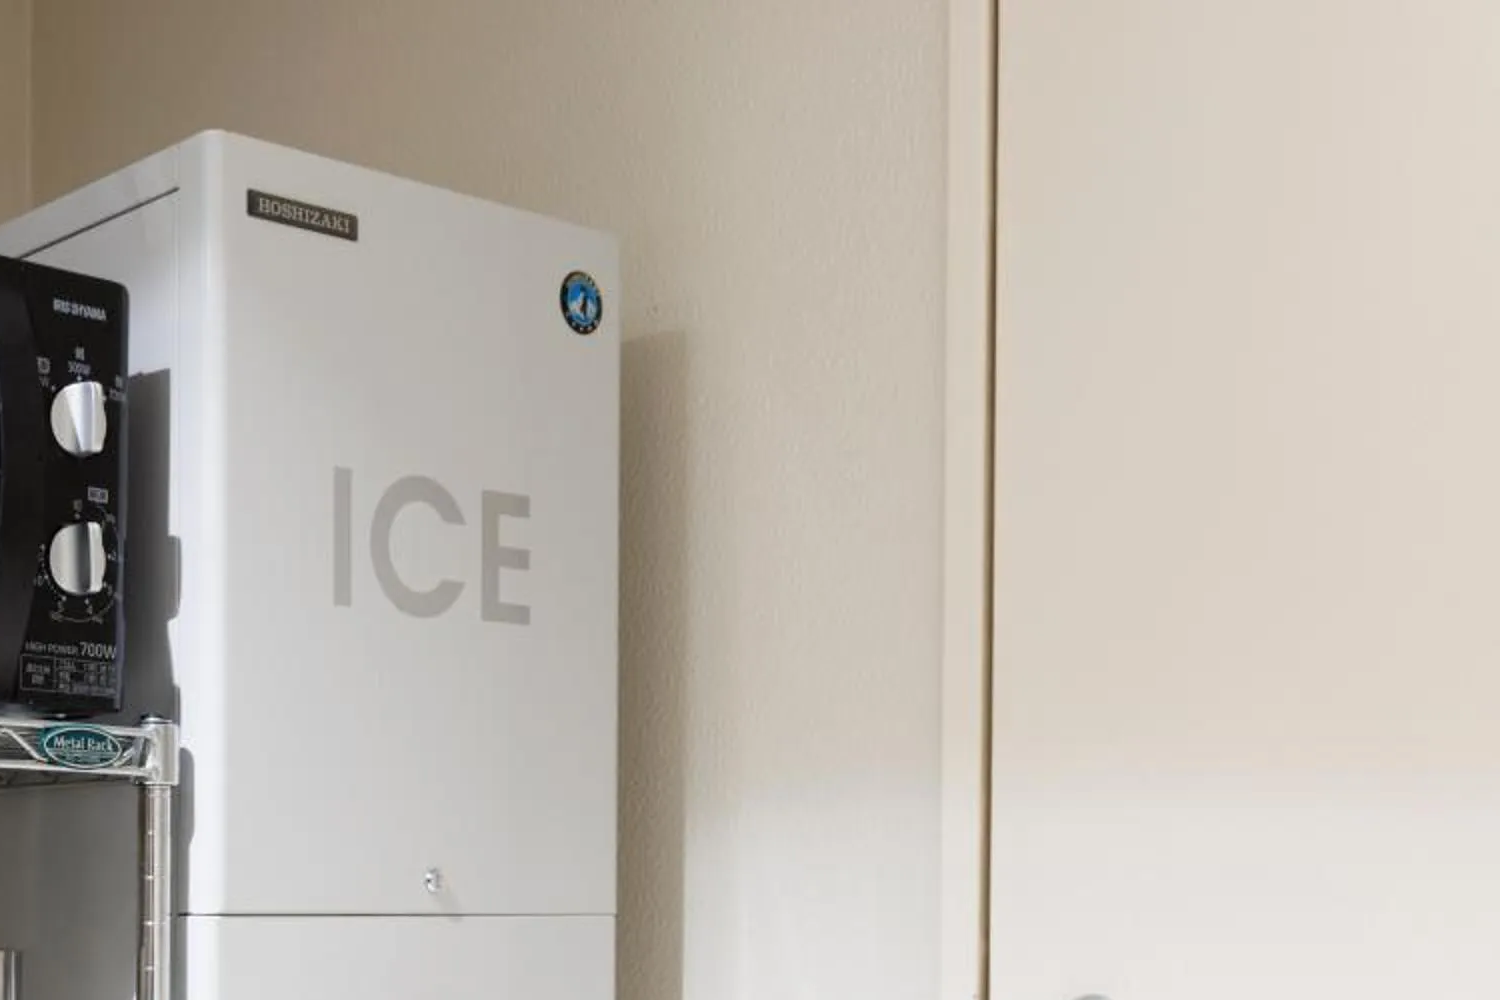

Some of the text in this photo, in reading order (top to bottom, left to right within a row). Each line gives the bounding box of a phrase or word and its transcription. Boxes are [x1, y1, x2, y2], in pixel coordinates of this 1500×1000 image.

[259, 197, 350, 234] HOSHIZAKI
[333, 465, 531, 626] ICE
[79, 641, 117, 660] 700W
[53, 736, 114, 752] Metal Rack
